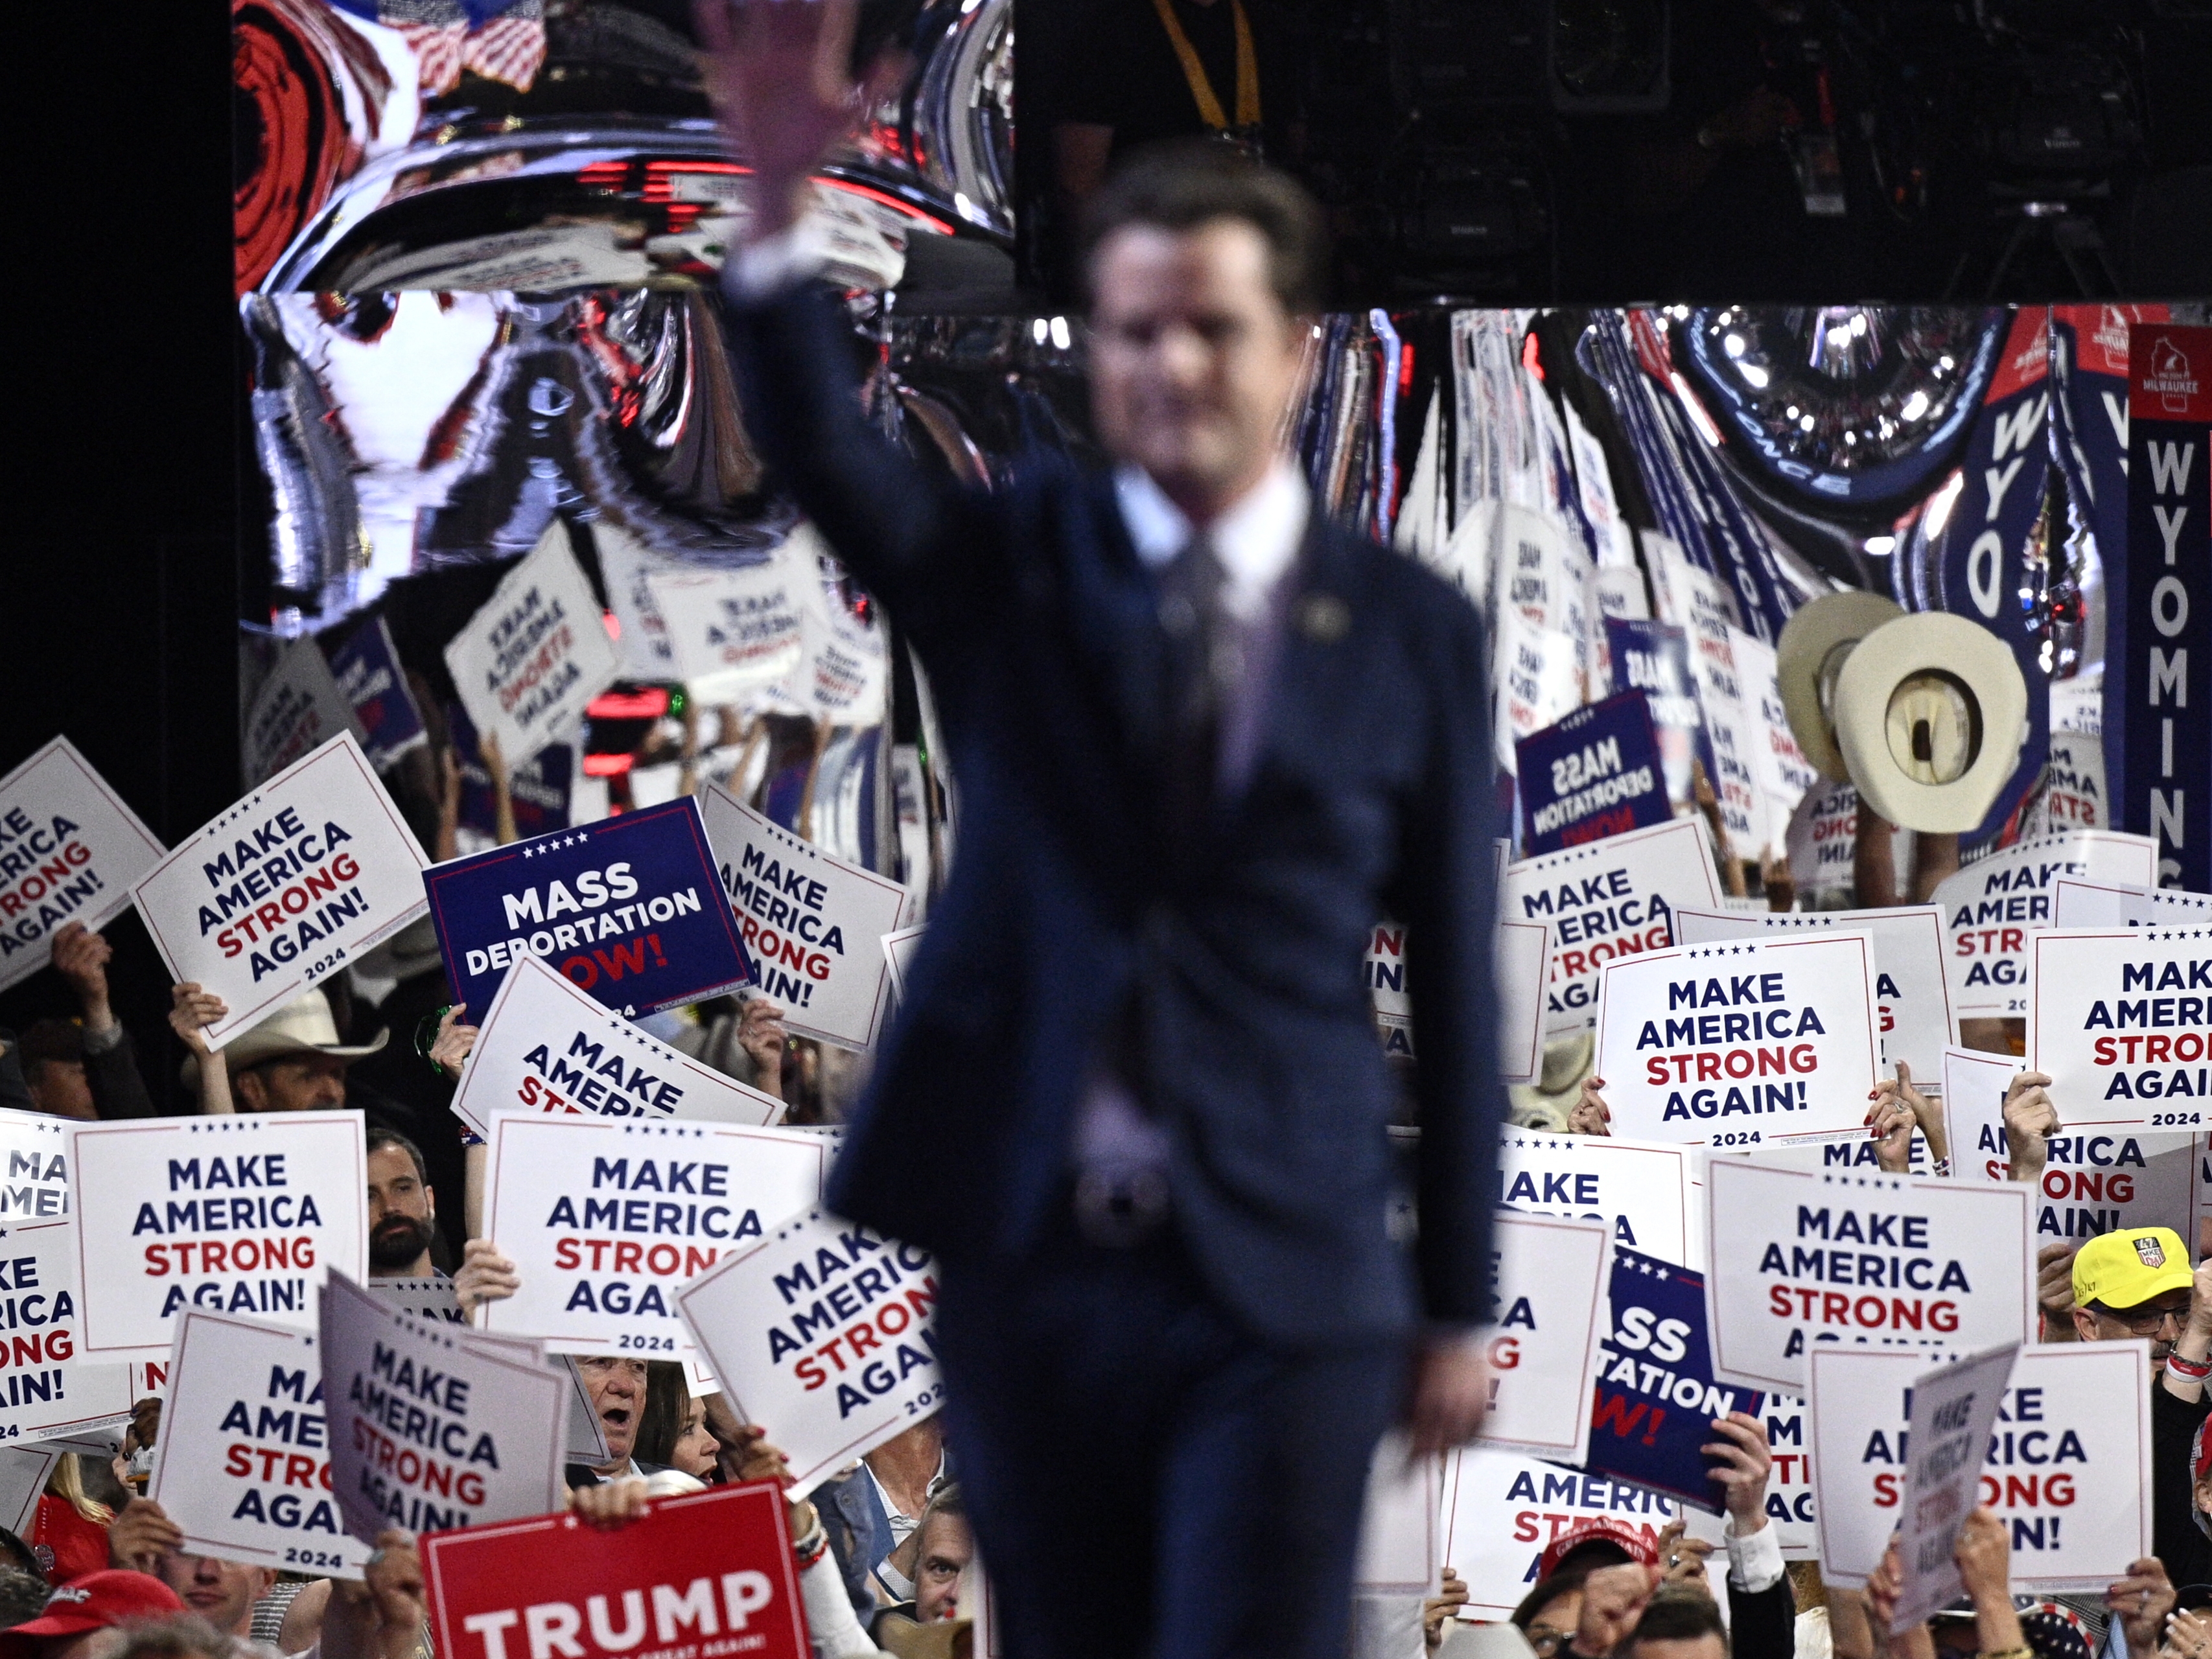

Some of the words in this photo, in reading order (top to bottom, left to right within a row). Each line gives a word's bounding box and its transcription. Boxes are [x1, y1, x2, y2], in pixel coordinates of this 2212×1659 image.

[2143, 379, 2198, 394] MILWAUKEE
[203, 806, 305, 888] MAKE
[198, 821, 353, 937] AMERICA
[501, 862, 639, 931] MASS
[741, 842, 828, 912] MAKE
[1522, 868, 1633, 919] MAKE
[0, 868, 104, 957] AGAIN!
[216, 852, 360, 958] STRONG
[721, 863, 845, 956] AMERICA
[1554, 893, 1671, 948] ERICA
[1950, 896, 2049, 930] AMER
[250, 886, 370, 983] AGAIN!
[465, 887, 702, 977] DEPORTATION
[1955, 927, 2035, 957] STR
[305, 947, 346, 981] 2024
[561, 933, 669, 991] OW!
[1668, 973, 1786, 1011] MAKE
[1635, 1006, 1826, 1051] AMERICA
[2093, 1033, 2212, 1066] STRO
[568, 1030, 684, 1115] MAKE
[1646, 1043, 1817, 1086] STRONG
[2104, 1068, 2212, 1100] AGAI
[1662, 1080, 1808, 1122] AGAIN!
[2151, 1112, 2201, 1126] 2024
[1712, 1130, 1762, 1147] 2024
[1824, 1137, 1925, 1167] MAE
[8, 1150, 67, 1184] MA
[167, 1154, 286, 1192] MAKE
[592, 1157, 730, 1197] MAKE
[132, 1195, 323, 1236] AMERICA
[546, 1196, 763, 1240] AMERICA
[1797, 1205, 1929, 1249] MAKE
[2037, 1206, 2120, 1238] AIN!
[145, 1236, 316, 1276] STRONG
[555, 1238, 736, 1277] STRON
[773, 1222, 889, 1305] MAK
[1758, 1242, 1972, 1294] AMERICA
[160, 1279, 305, 1318] AGAIN!
[565, 1280, 681, 1318] AGA
[767, 1240, 931, 1365] AMERIC
[1769, 1283, 1959, 1332] STRONG
[618, 1334, 675, 1351] 2024
[794, 1274, 940, 1391] STRON
[1614, 1306, 1692, 1363] SS
[372, 1341, 469, 1415] MAKE
[905, 1382, 944, 1416] 202
[1594, 1350, 1735, 1420] TATION
[350, 1371, 499, 1470] AMERICA
[1591, 1387, 1666, 1445] W!
[225, 1444, 332, 1490] STR
[352, 1417, 486, 1507] STRONG
[232, 1488, 351, 1535] AGA
[360, 1465, 469, 1532] AGAIN!
[285, 1547, 343, 1569] 2024
[463, 1569, 773, 1659] TRUMP
